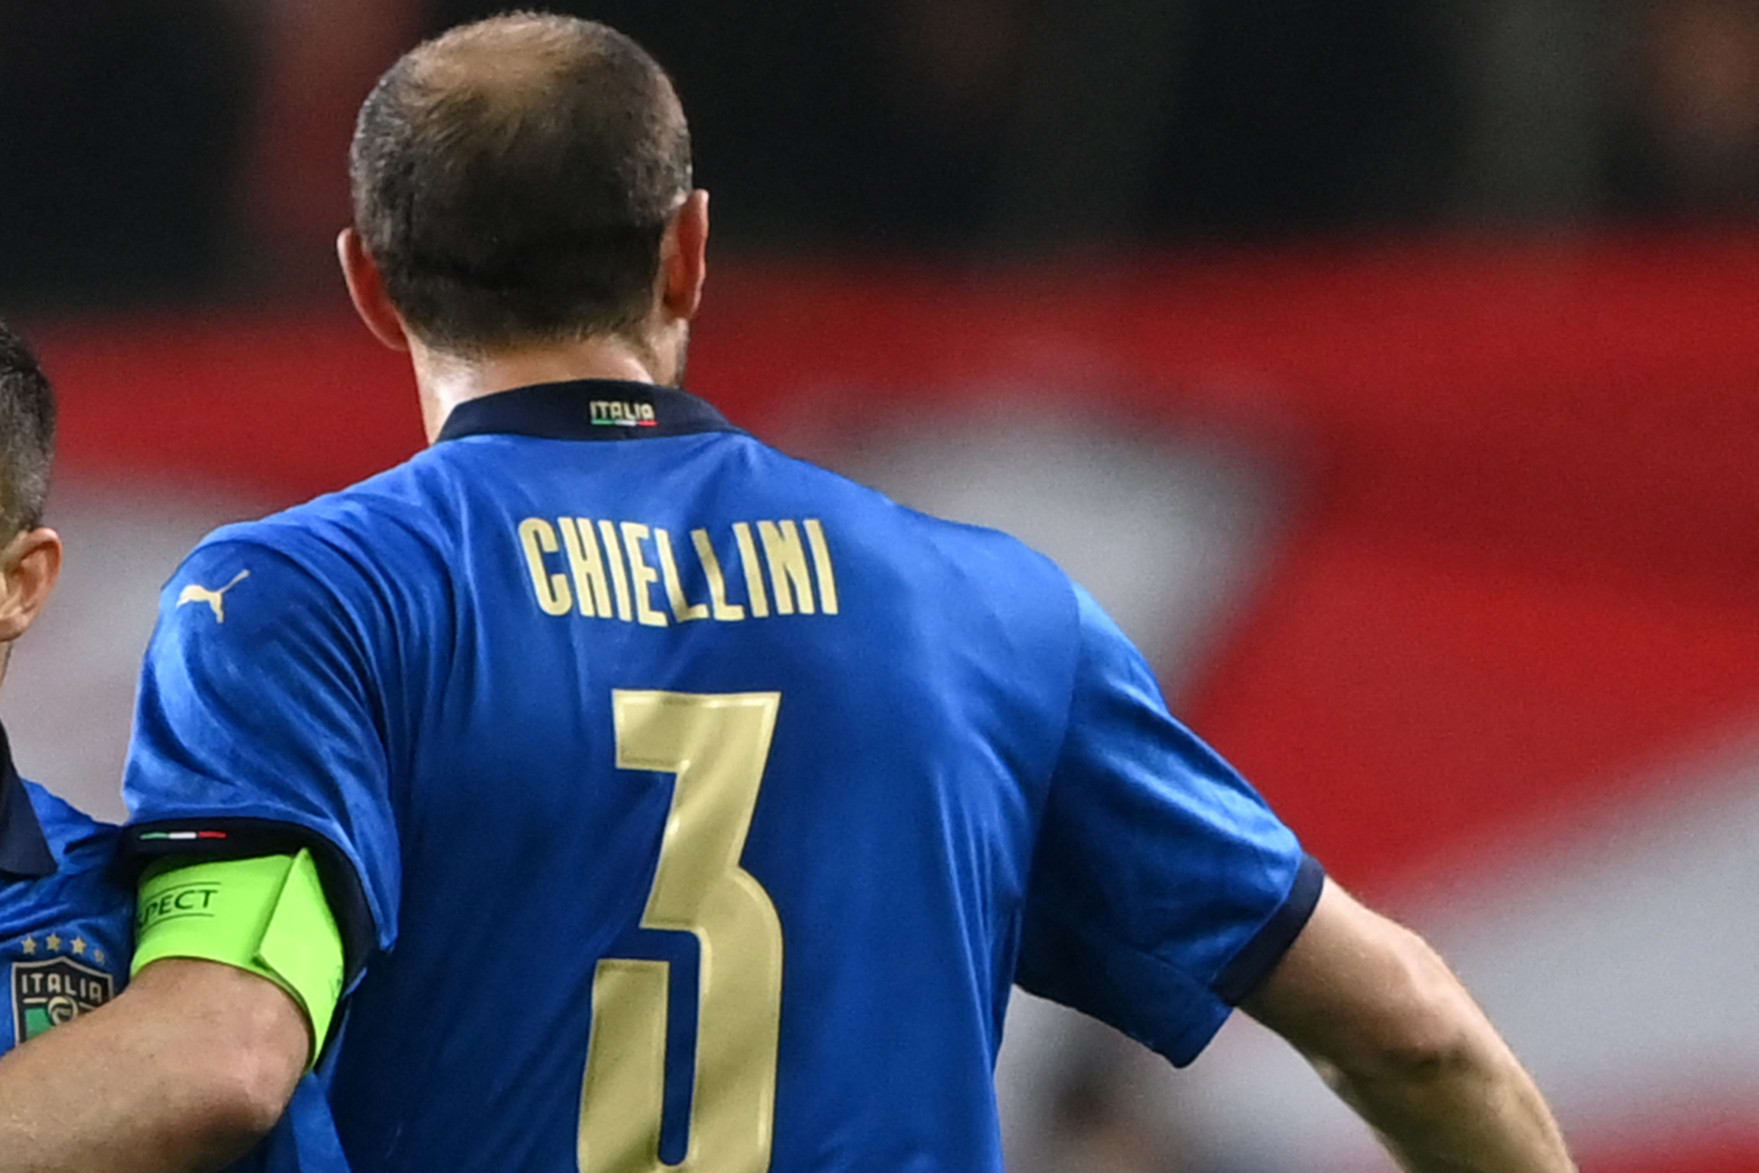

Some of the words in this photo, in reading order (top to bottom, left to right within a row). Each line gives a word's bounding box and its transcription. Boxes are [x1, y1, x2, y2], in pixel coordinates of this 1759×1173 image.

[590, 401, 656, 421] ITALIA
[518, 516, 838, 627] CHIELLINI
[21, 972, 103, 1004] ITALIA
